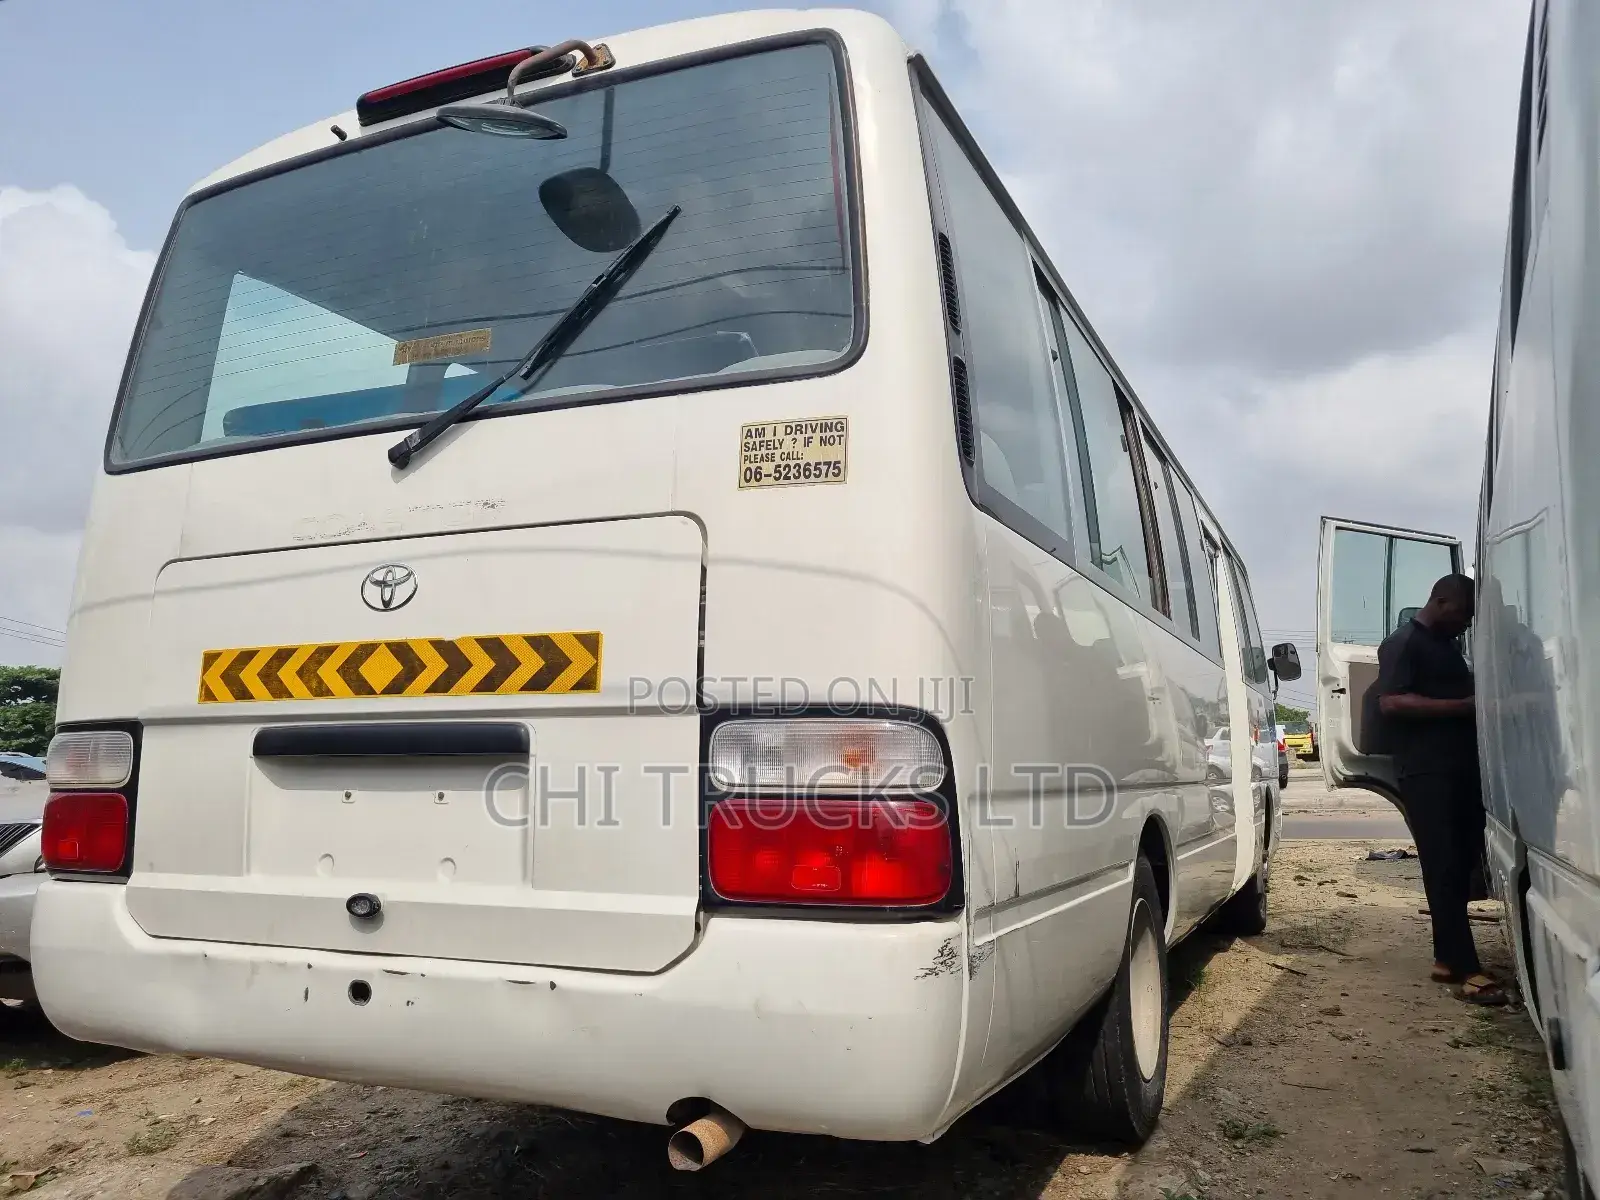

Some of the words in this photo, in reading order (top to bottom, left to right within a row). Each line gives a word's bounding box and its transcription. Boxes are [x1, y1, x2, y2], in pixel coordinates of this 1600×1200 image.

[744, 427, 766, 439] AM
[773, 425, 777, 437] I
[784, 421, 845, 436] DRIVING
[743, 438, 785, 452] SAFELY
[791, 437, 798, 449] ?
[803, 436, 814, 447] IF
[819, 435, 844, 447] NOT
[743, 452, 776, 464] PLEASE
[779, 450, 804, 462] CALL:
[743, 460, 842, 484] 06-5236575
